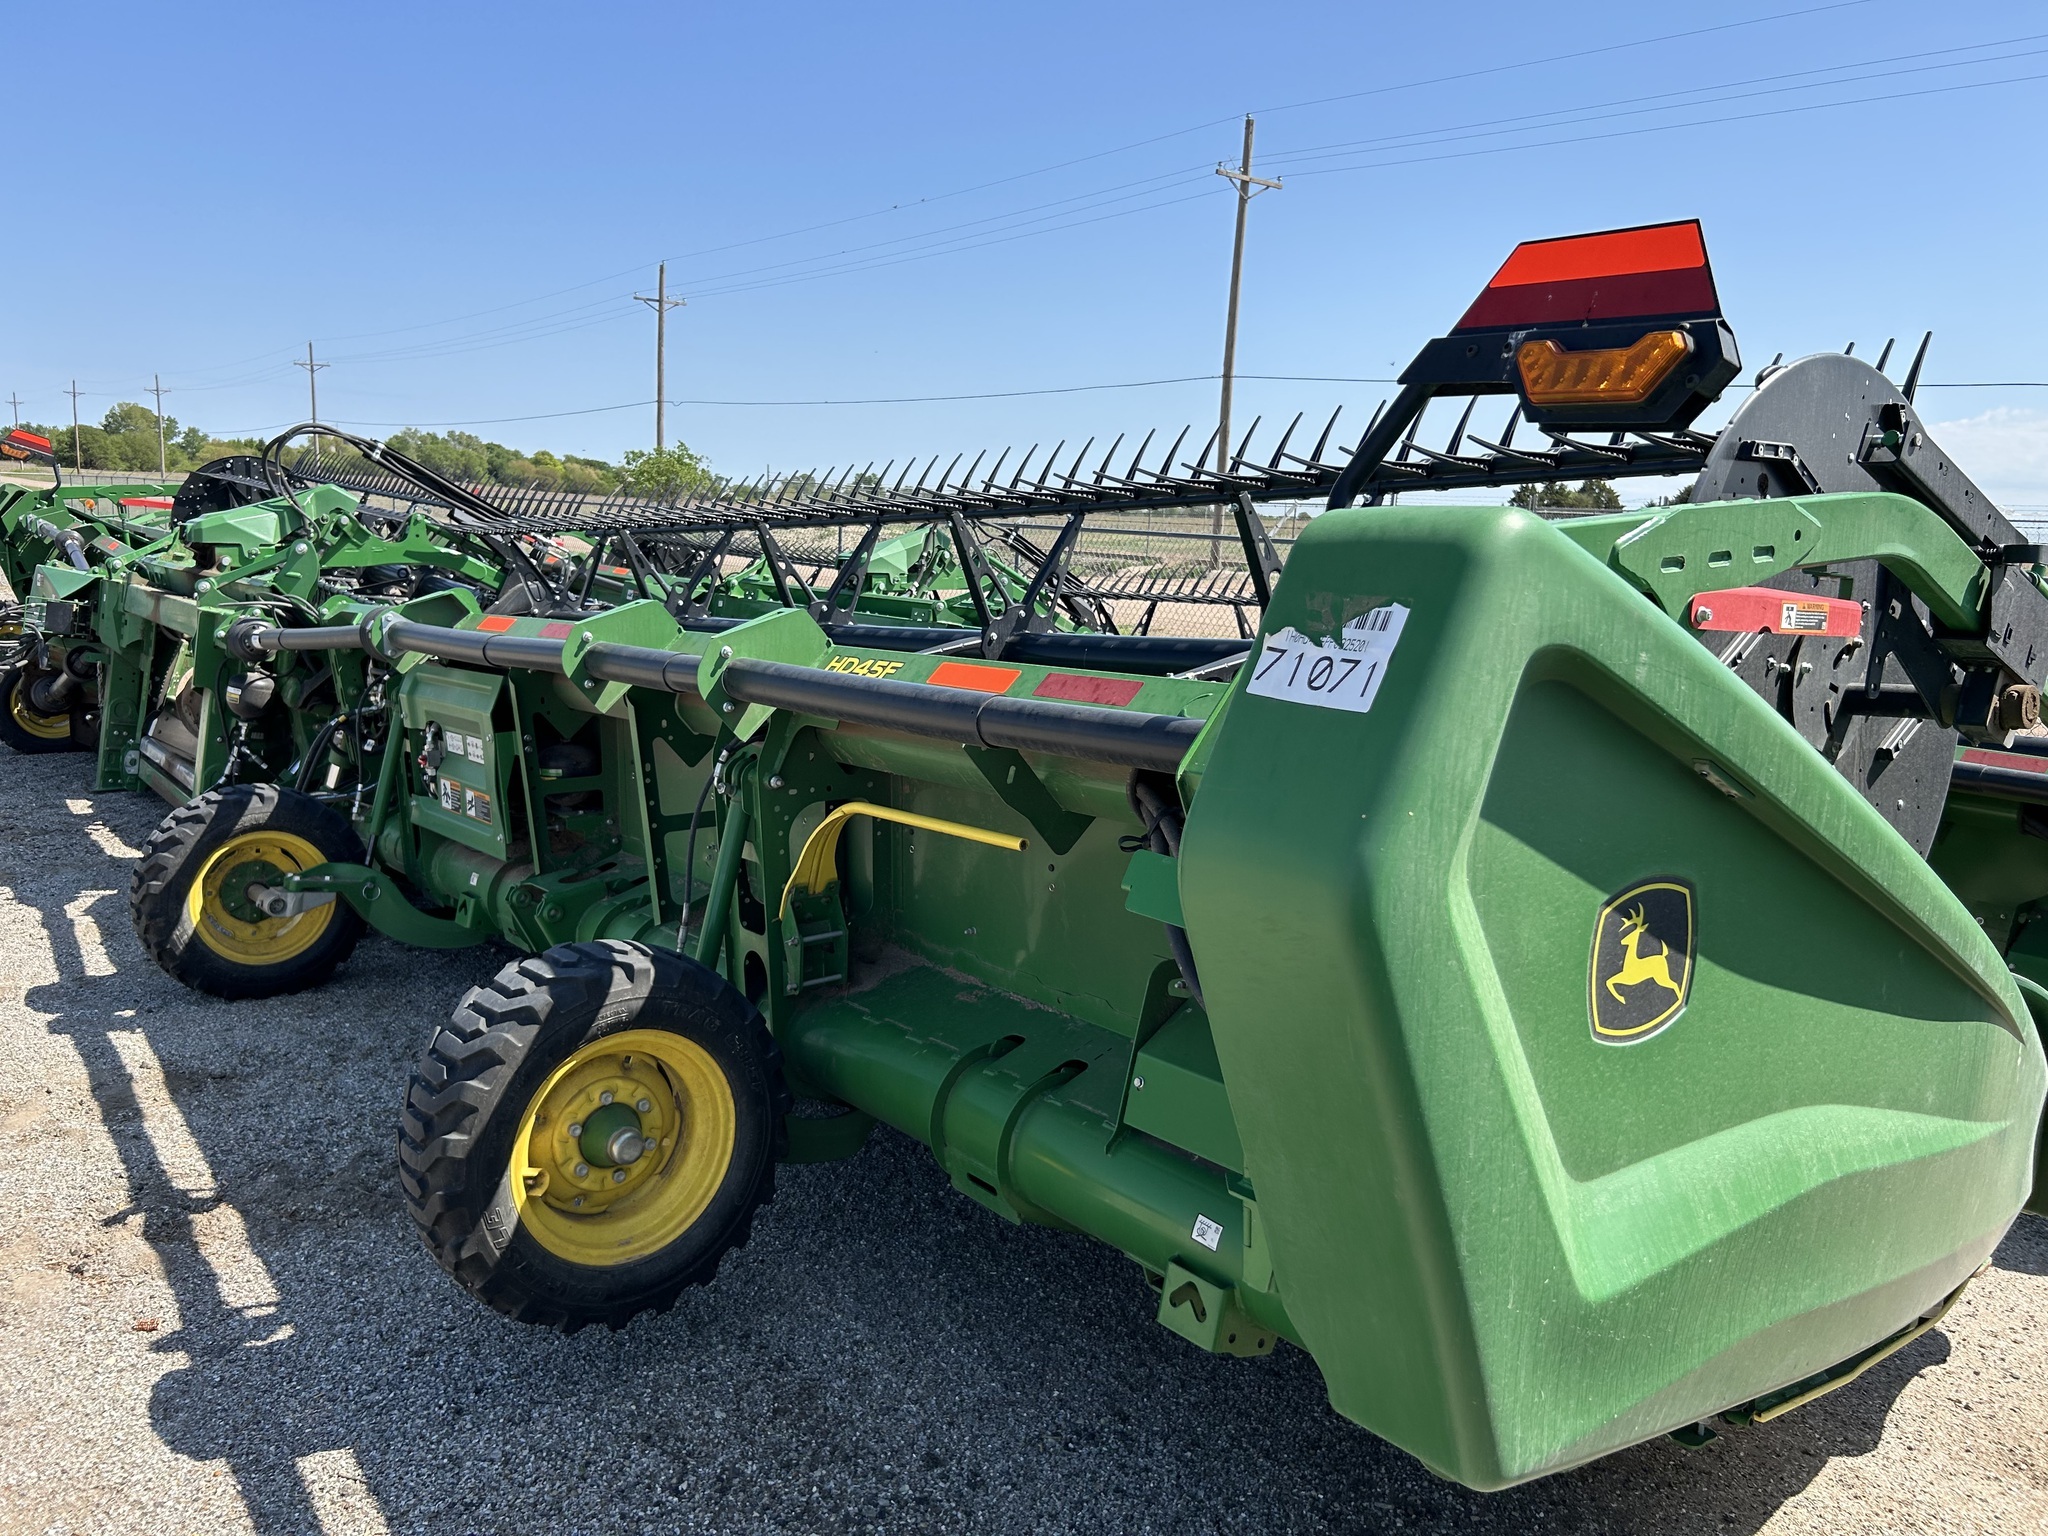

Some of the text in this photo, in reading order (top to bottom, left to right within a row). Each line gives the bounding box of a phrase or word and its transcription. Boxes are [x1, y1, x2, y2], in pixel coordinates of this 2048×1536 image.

[1806, 602, 1825, 611] WARNING
[824, 655, 905, 679] HD45F
[1254, 645, 1378, 698] 71071
